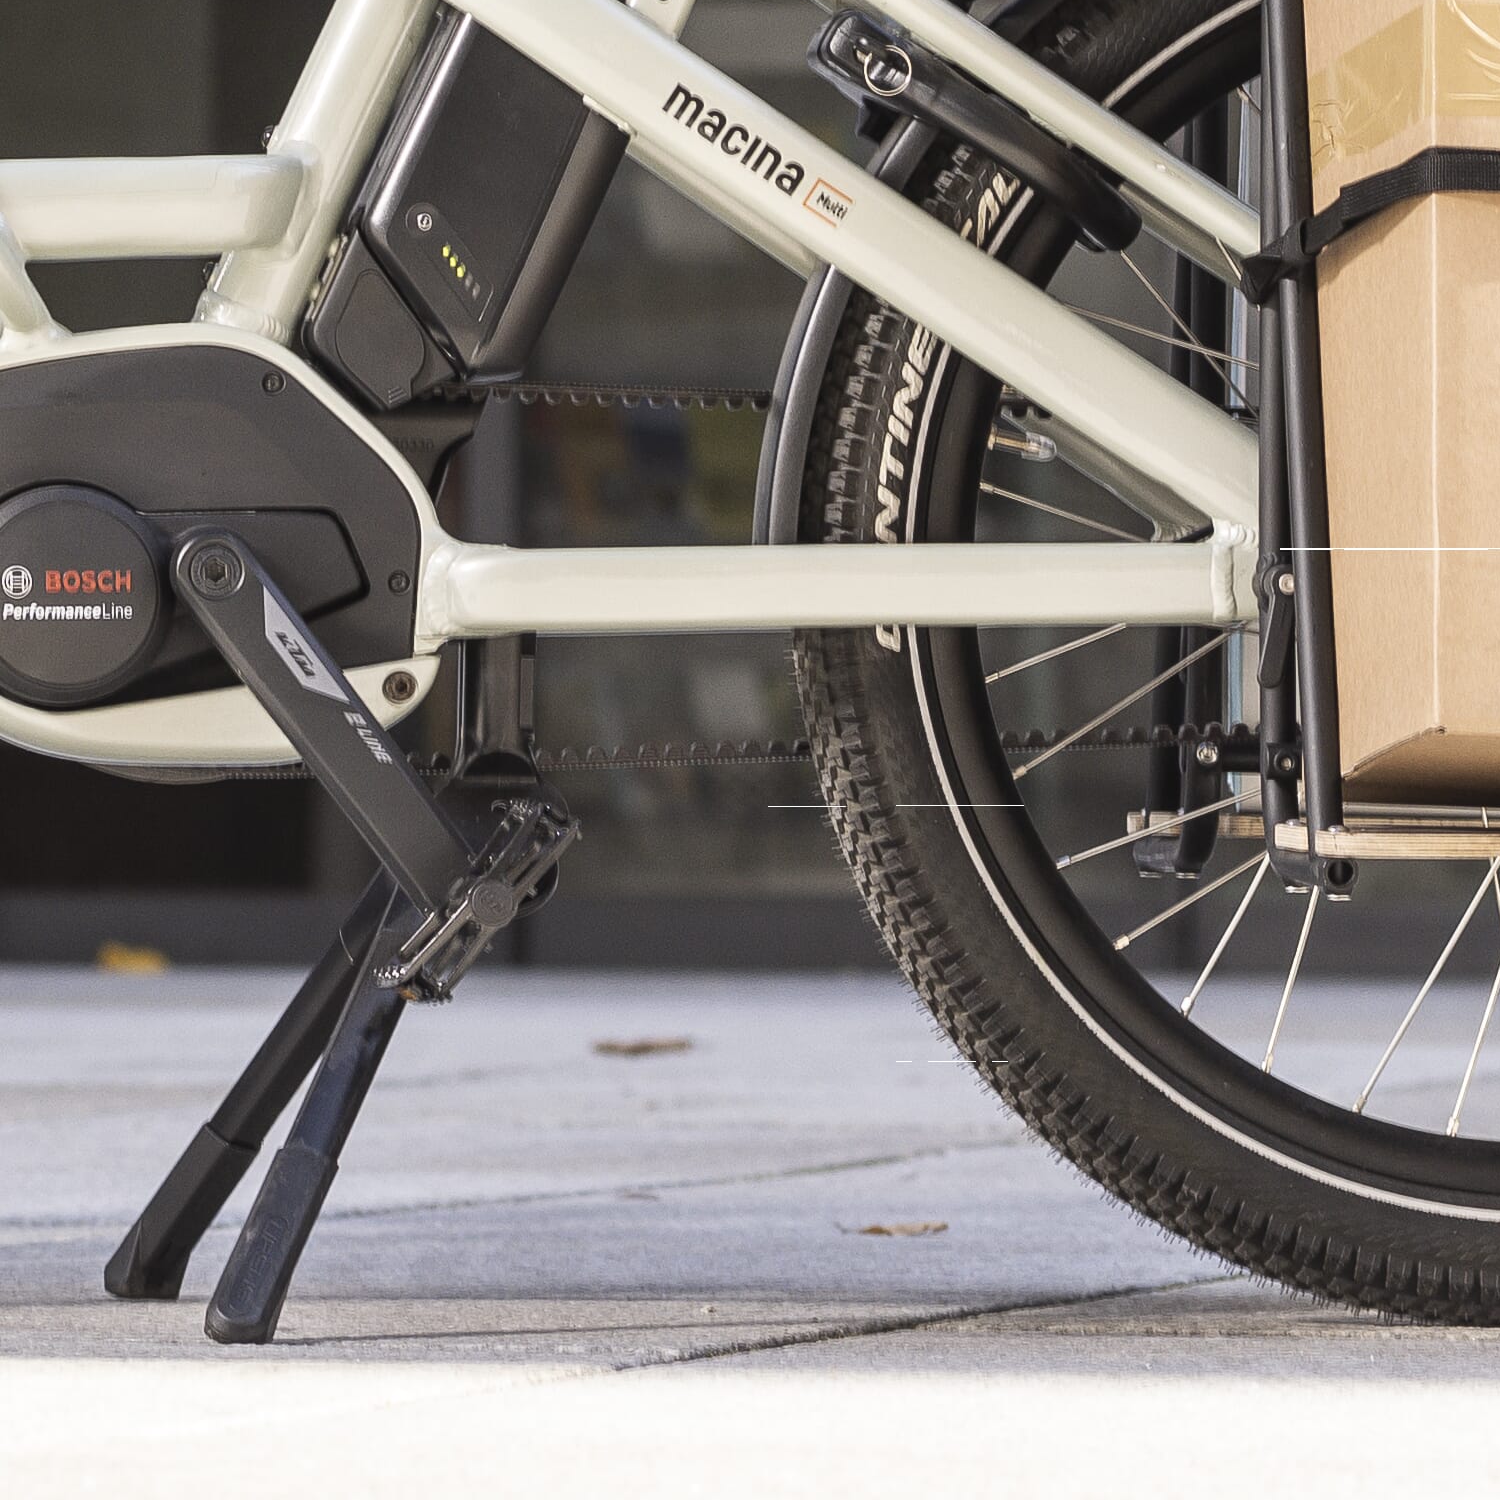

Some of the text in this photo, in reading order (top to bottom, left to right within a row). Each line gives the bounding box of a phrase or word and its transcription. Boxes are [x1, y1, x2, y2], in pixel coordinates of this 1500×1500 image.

[662, 82, 806, 197] macina
[815, 190, 848, 222] Multi
[45, 569, 131, 594] BOSCH
[275, 630, 315, 677] KTM
